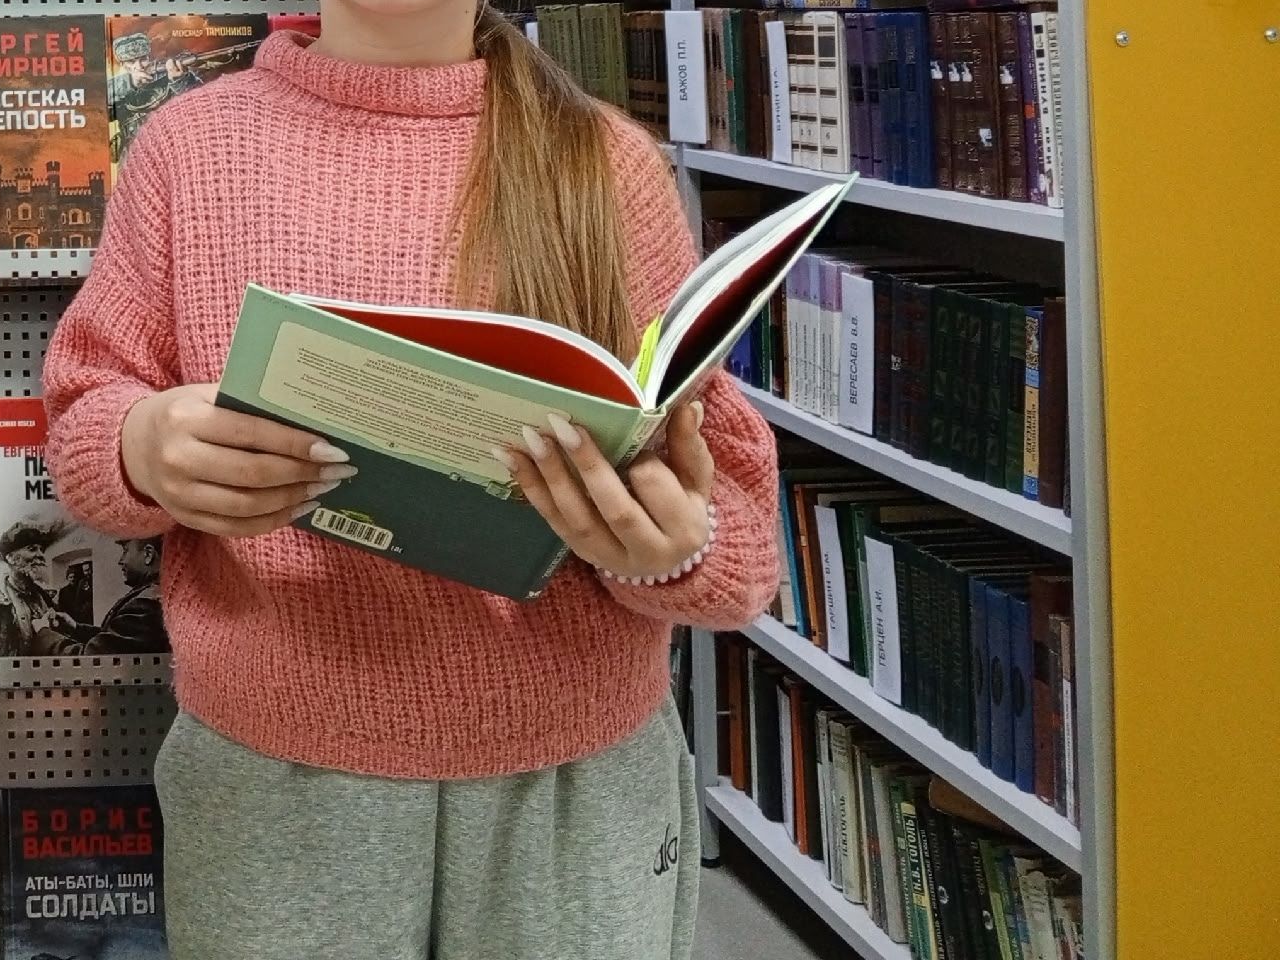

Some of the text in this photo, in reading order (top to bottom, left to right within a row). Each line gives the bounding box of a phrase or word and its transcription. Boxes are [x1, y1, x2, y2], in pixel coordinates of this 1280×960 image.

[205, 26, 253, 37] ТАМОНИКОВ
[677, 40, 688, 101] БАЖОВ П.П.
[1038, 62, 1049, 115] БУНИН
[849, 315, 858, 405] ВЕРЕСАЕВ В.В.
[825, 581, 836, 630] ГАРШИН
[874, 589, 887, 667] ГЕРЦЕН А.И.
[22, 807, 153, 833] БОРИС
[23, 834, 153, 860] ВАСИЛЬЕВ
[905, 819, 921, 891] Н.В. ГОГОЛЬ
[25, 872, 154, 891] АТЫ-БАТЫ, ШЛИ
[26, 891, 156, 920] СОЛДАТЫ
